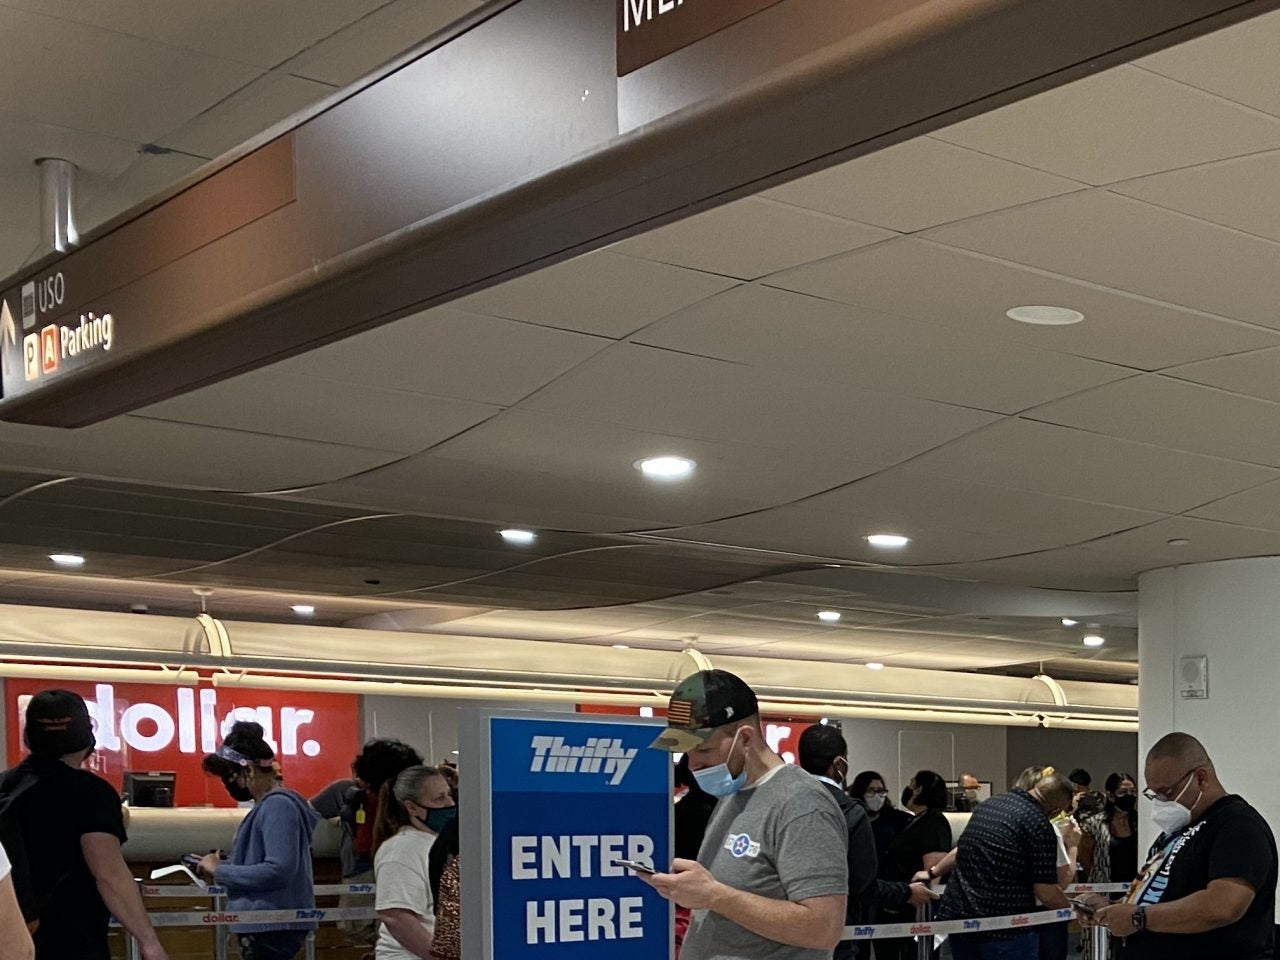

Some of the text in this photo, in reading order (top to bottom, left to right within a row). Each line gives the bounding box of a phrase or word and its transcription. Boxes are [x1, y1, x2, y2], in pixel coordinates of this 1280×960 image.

[38, 272, 65, 313] USO
[60, 311, 113, 360] Parking
[530, 735, 638, 786] Thrifty
[511, 834, 655, 881] ENTER
[526, 896, 644, 945] HERE
